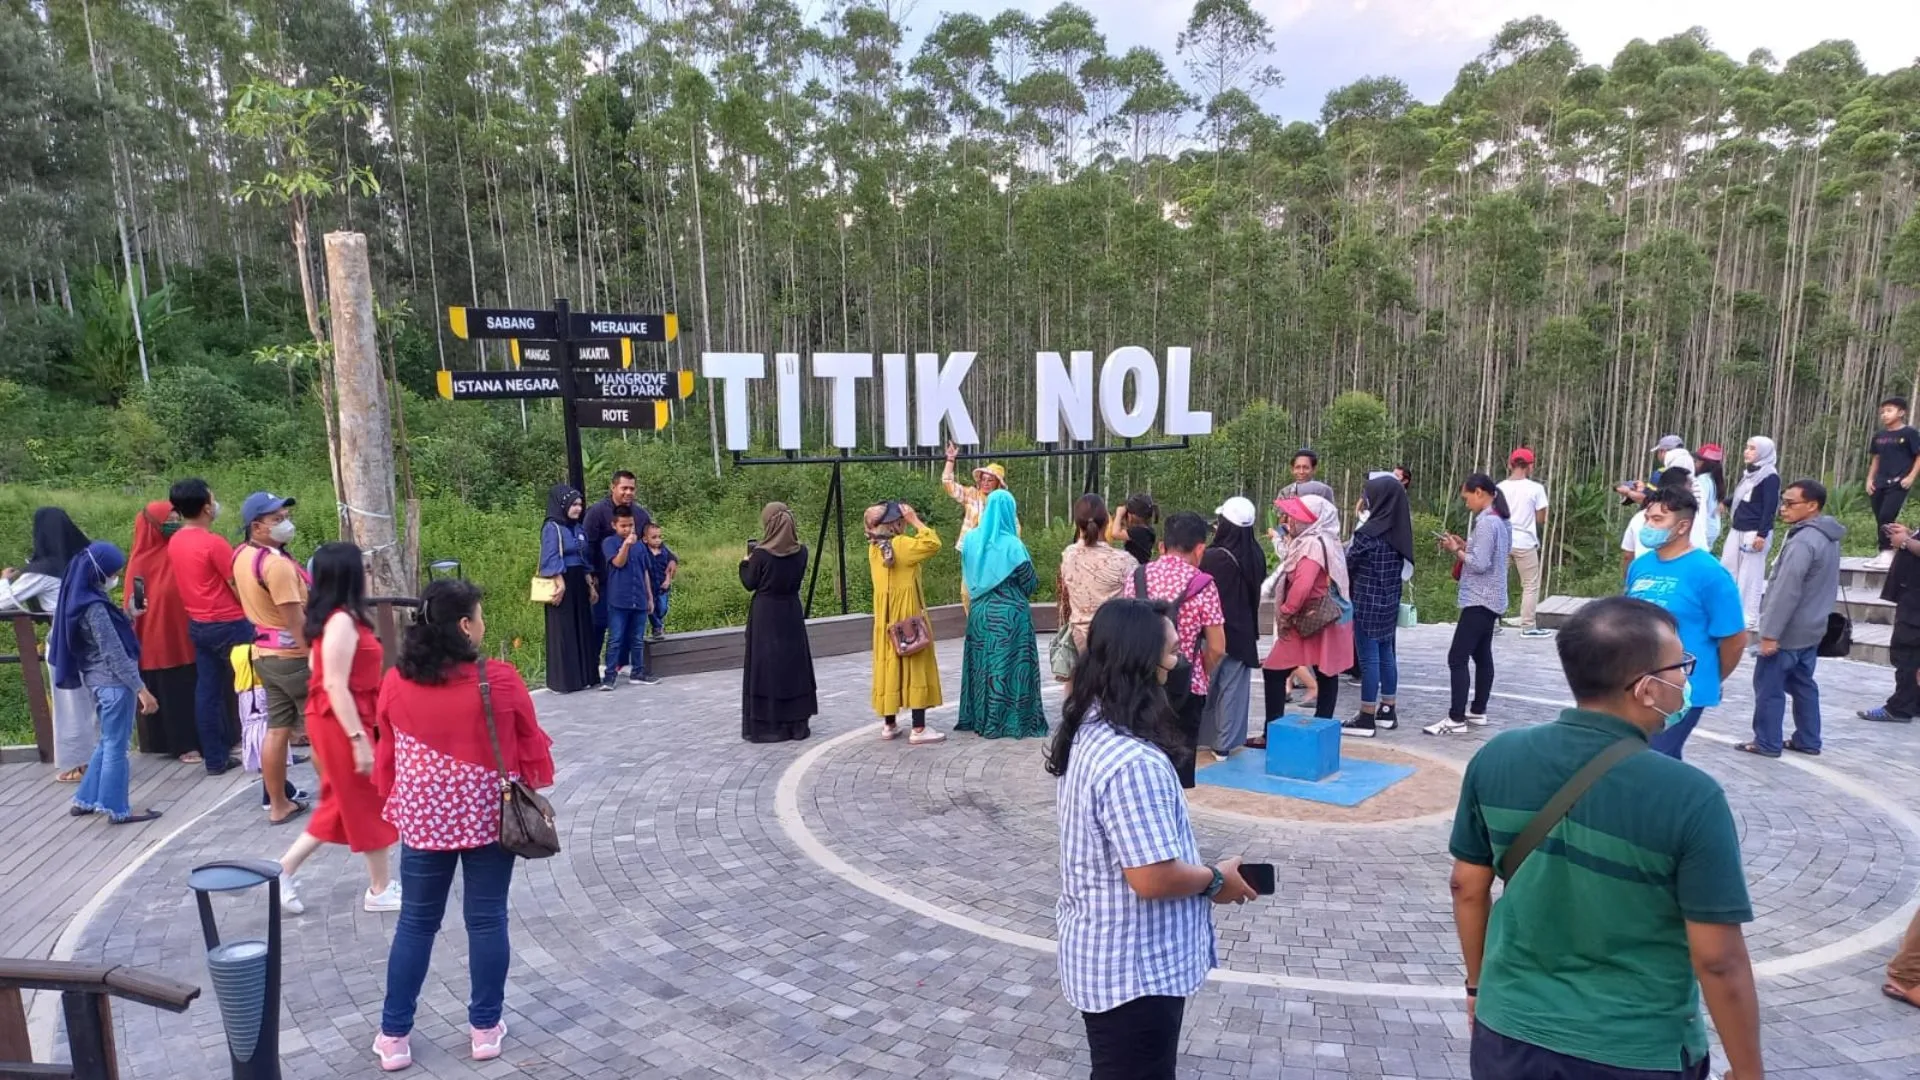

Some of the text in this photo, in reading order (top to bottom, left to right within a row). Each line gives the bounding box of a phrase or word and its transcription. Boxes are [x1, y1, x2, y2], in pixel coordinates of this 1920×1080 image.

[486, 316, 535, 330] SABANG
[590, 321, 648, 335] MERAUKE
[579, 347, 610, 360] JAKARTA
[453, 377, 560, 393] ISTANA NEGARA
[594, 372, 667, 385] MANGROVE
[602, 384, 665, 397] ECO PARK
[701, 345, 1213, 452] TITIK NOL
[602, 409, 629, 422] ROTE
